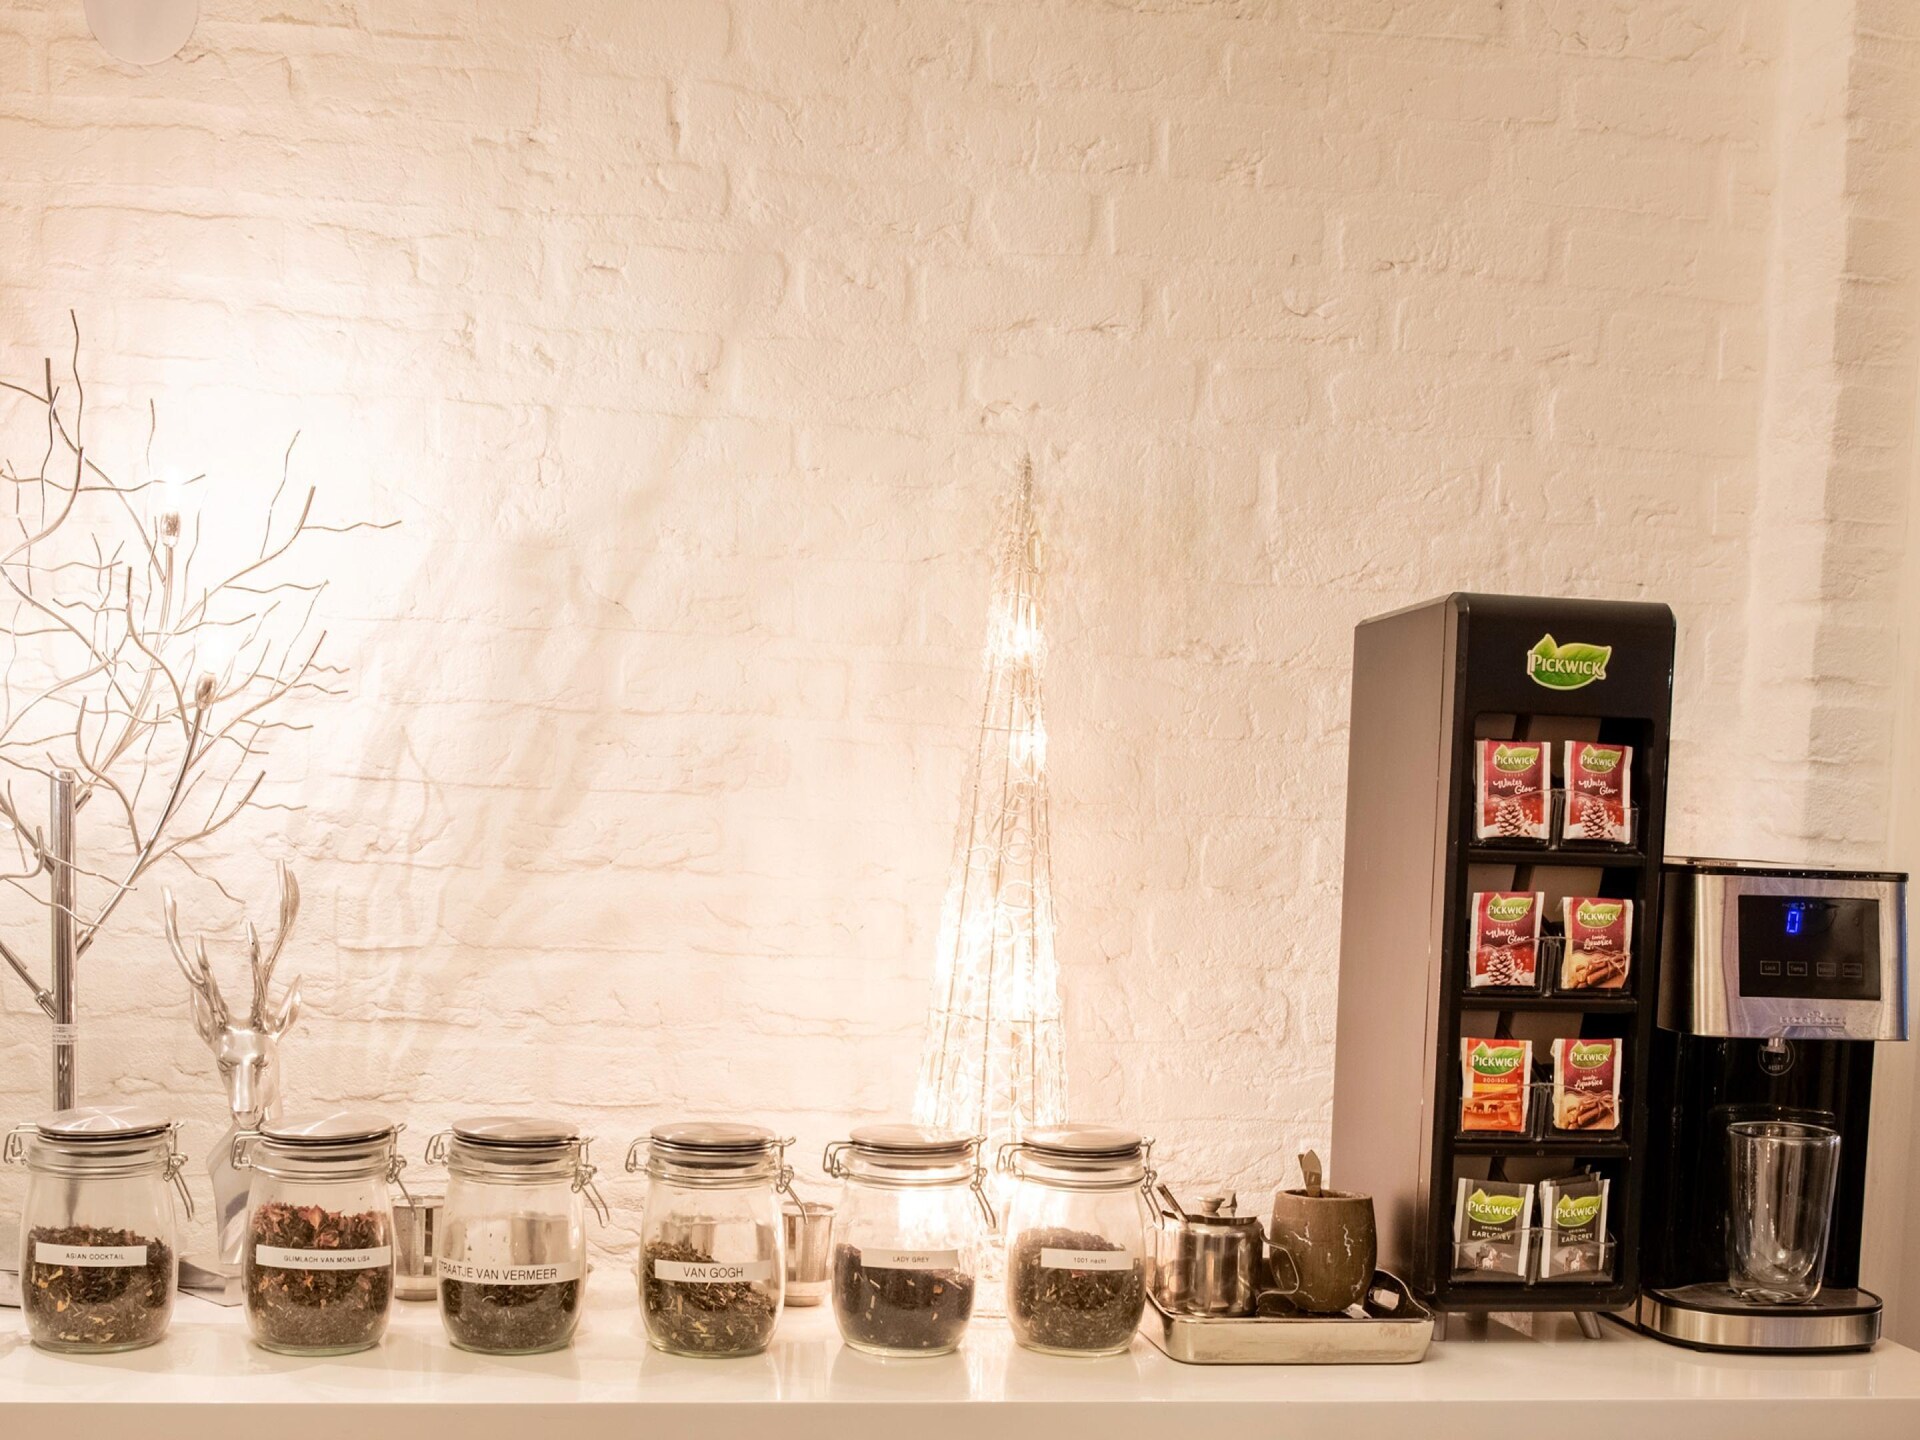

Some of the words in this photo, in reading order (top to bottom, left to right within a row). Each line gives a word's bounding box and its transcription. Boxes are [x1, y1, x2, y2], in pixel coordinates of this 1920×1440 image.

[1530, 653, 1603, 676] PICKWICK
[1494, 754, 1536, 766] PICKWICK
[1580, 754, 1617, 768] PICKWICK
[1487, 904, 1528, 915] PICKWICK
[1577, 910, 1618, 921] PICKWICK
[1471, 1054, 1520, 1068] PICKWICK
[1570, 1052, 1609, 1062] PICKWICK
[1467, 1200, 1519, 1217] PICKWICK
[1555, 1205, 1598, 1220] PICKWICK
[65, 1252, 87, 1260] ASIAN
[283, 1255, 318, 1263] GLIMLACH
[476, 1268, 499, 1280] VAN
[502, 1267, 558, 1281] VERMEER
[683, 1267, 706, 1278] VAN
[709, 1266, 744, 1279] GOGH
